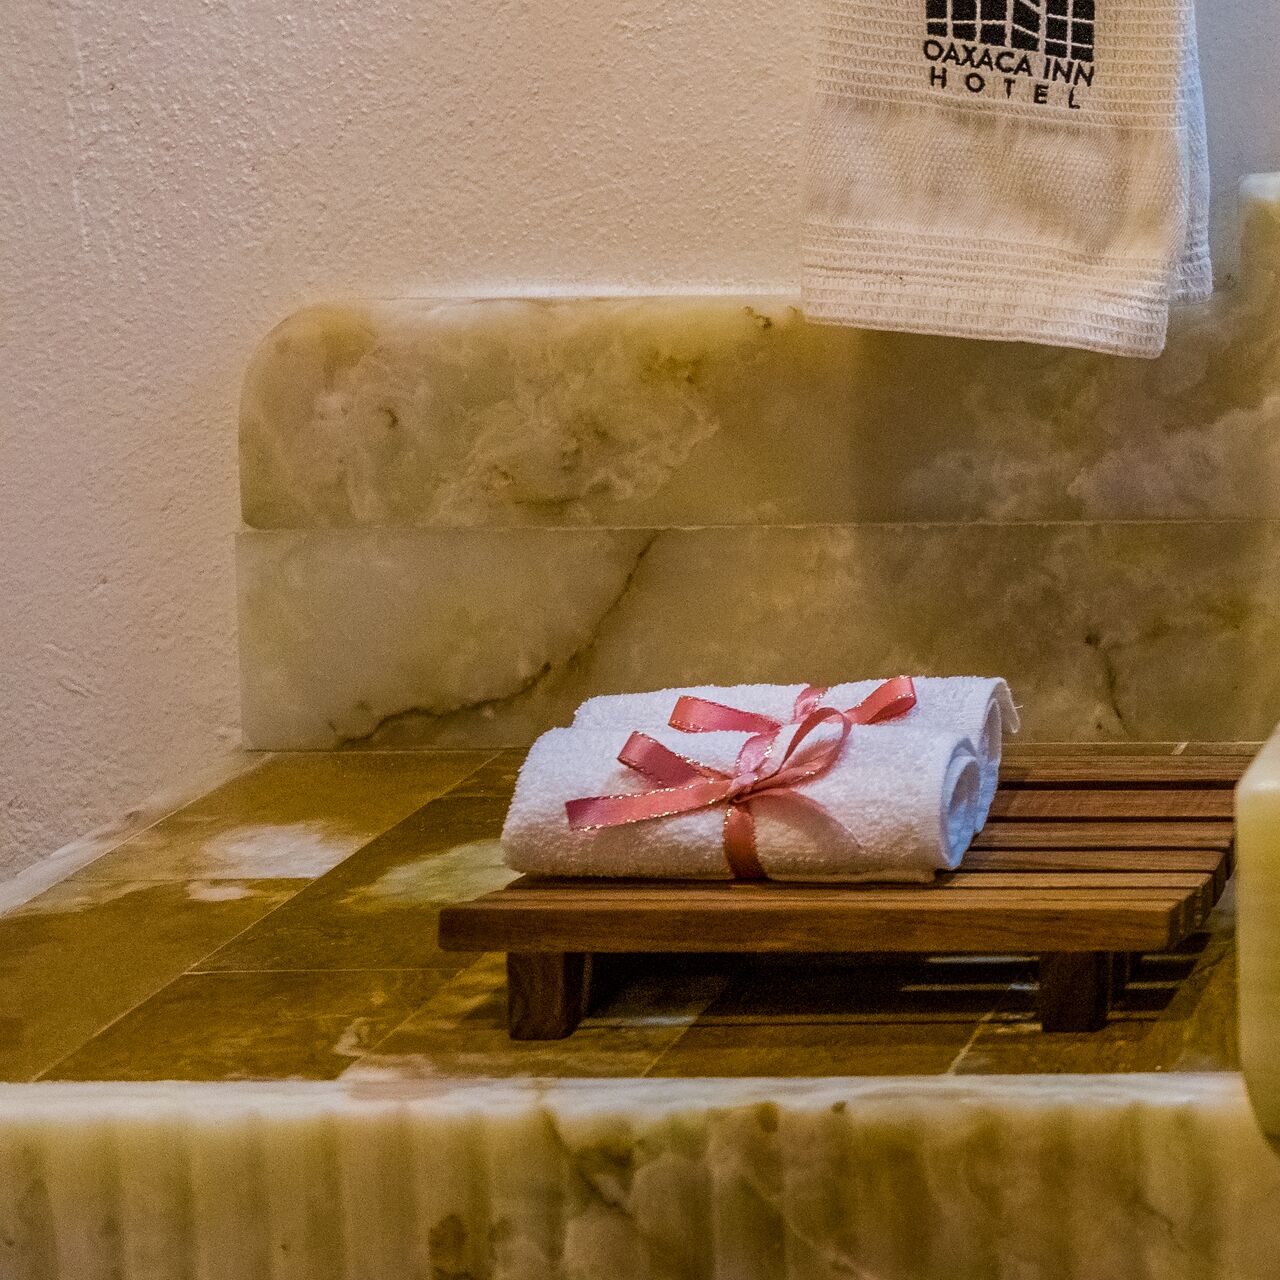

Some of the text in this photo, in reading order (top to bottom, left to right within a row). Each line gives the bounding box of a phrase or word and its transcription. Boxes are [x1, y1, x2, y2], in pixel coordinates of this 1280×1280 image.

[923, 39, 1095, 88] OAXACA INN
[930, 66, 1081, 110] HOTEL
